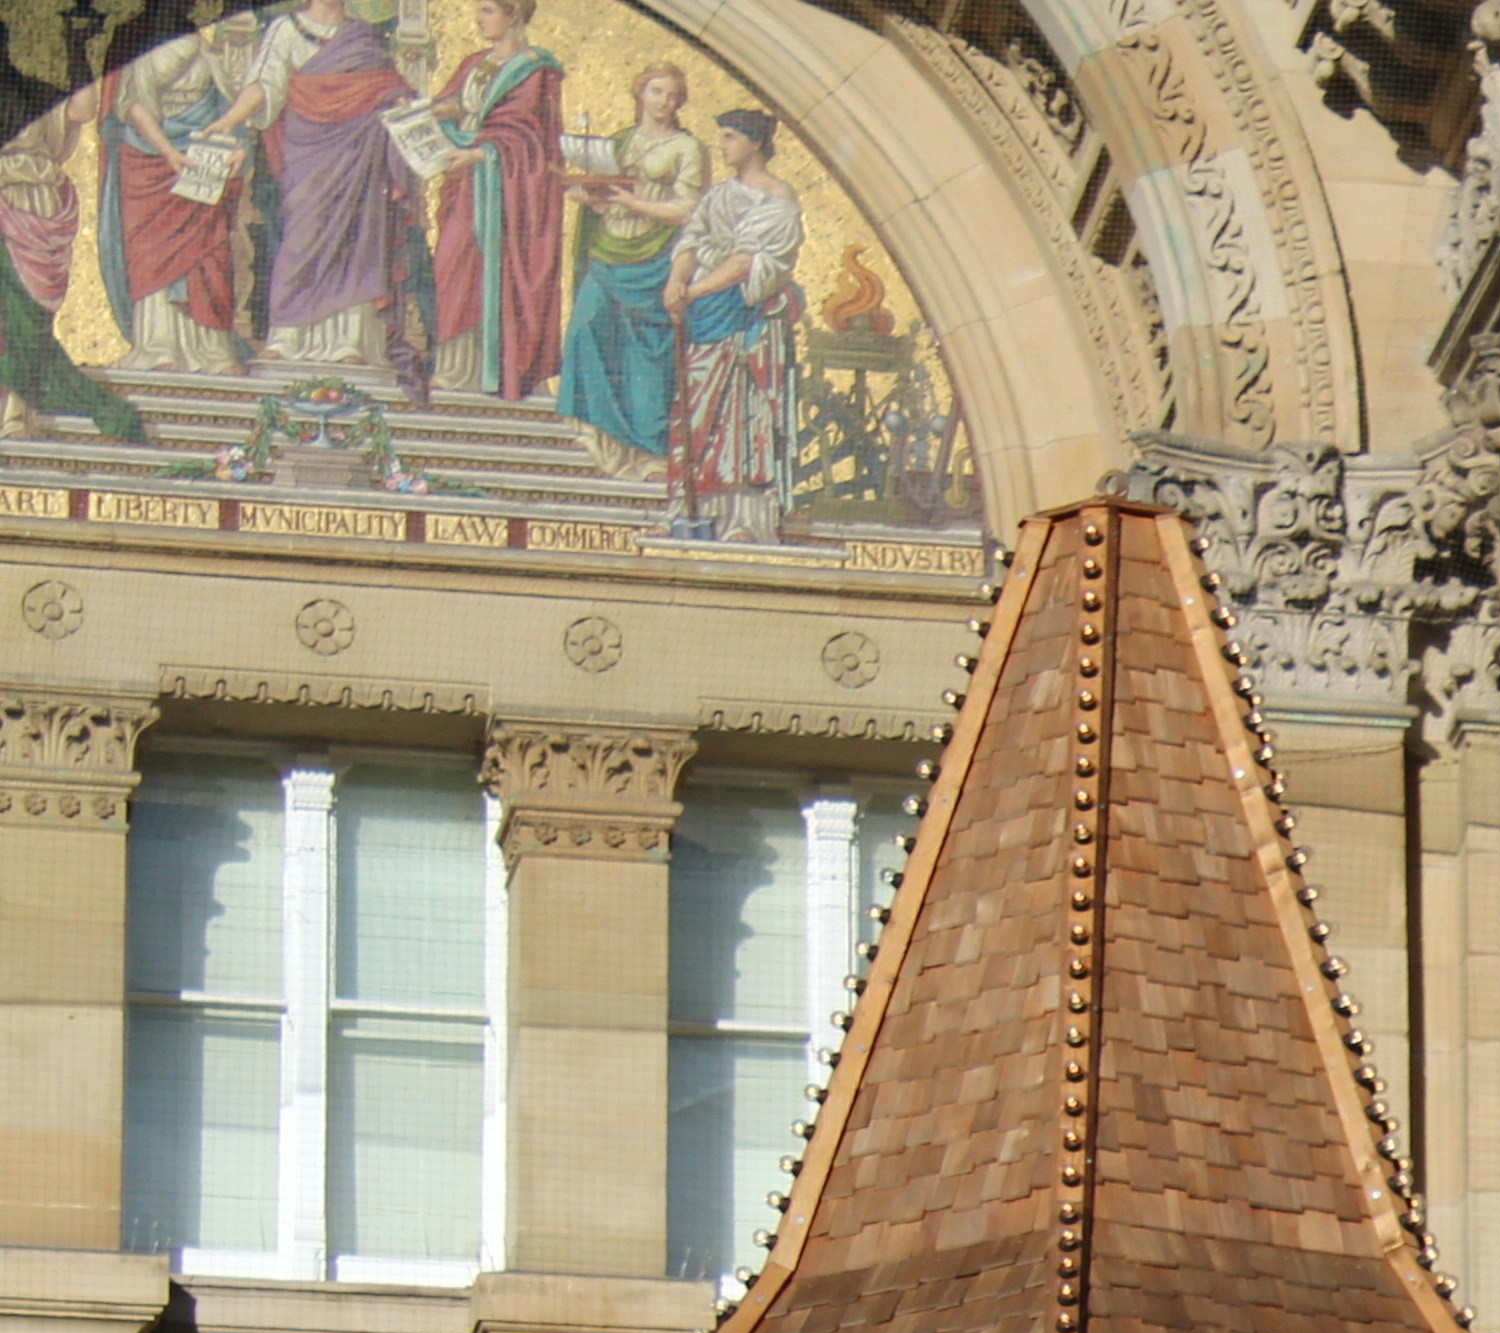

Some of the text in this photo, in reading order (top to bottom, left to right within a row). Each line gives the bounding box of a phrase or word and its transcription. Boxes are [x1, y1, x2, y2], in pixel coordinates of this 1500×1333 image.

[0, 489, 57, 515] ART
[95, 493, 213, 525] LIBERTY
[240, 505, 406, 537] MVNICIPALITY
[432, 515, 502, 544] LAW
[528, 525, 636, 553] COMMERCE
[851, 544, 982, 572] INDVSTRY
